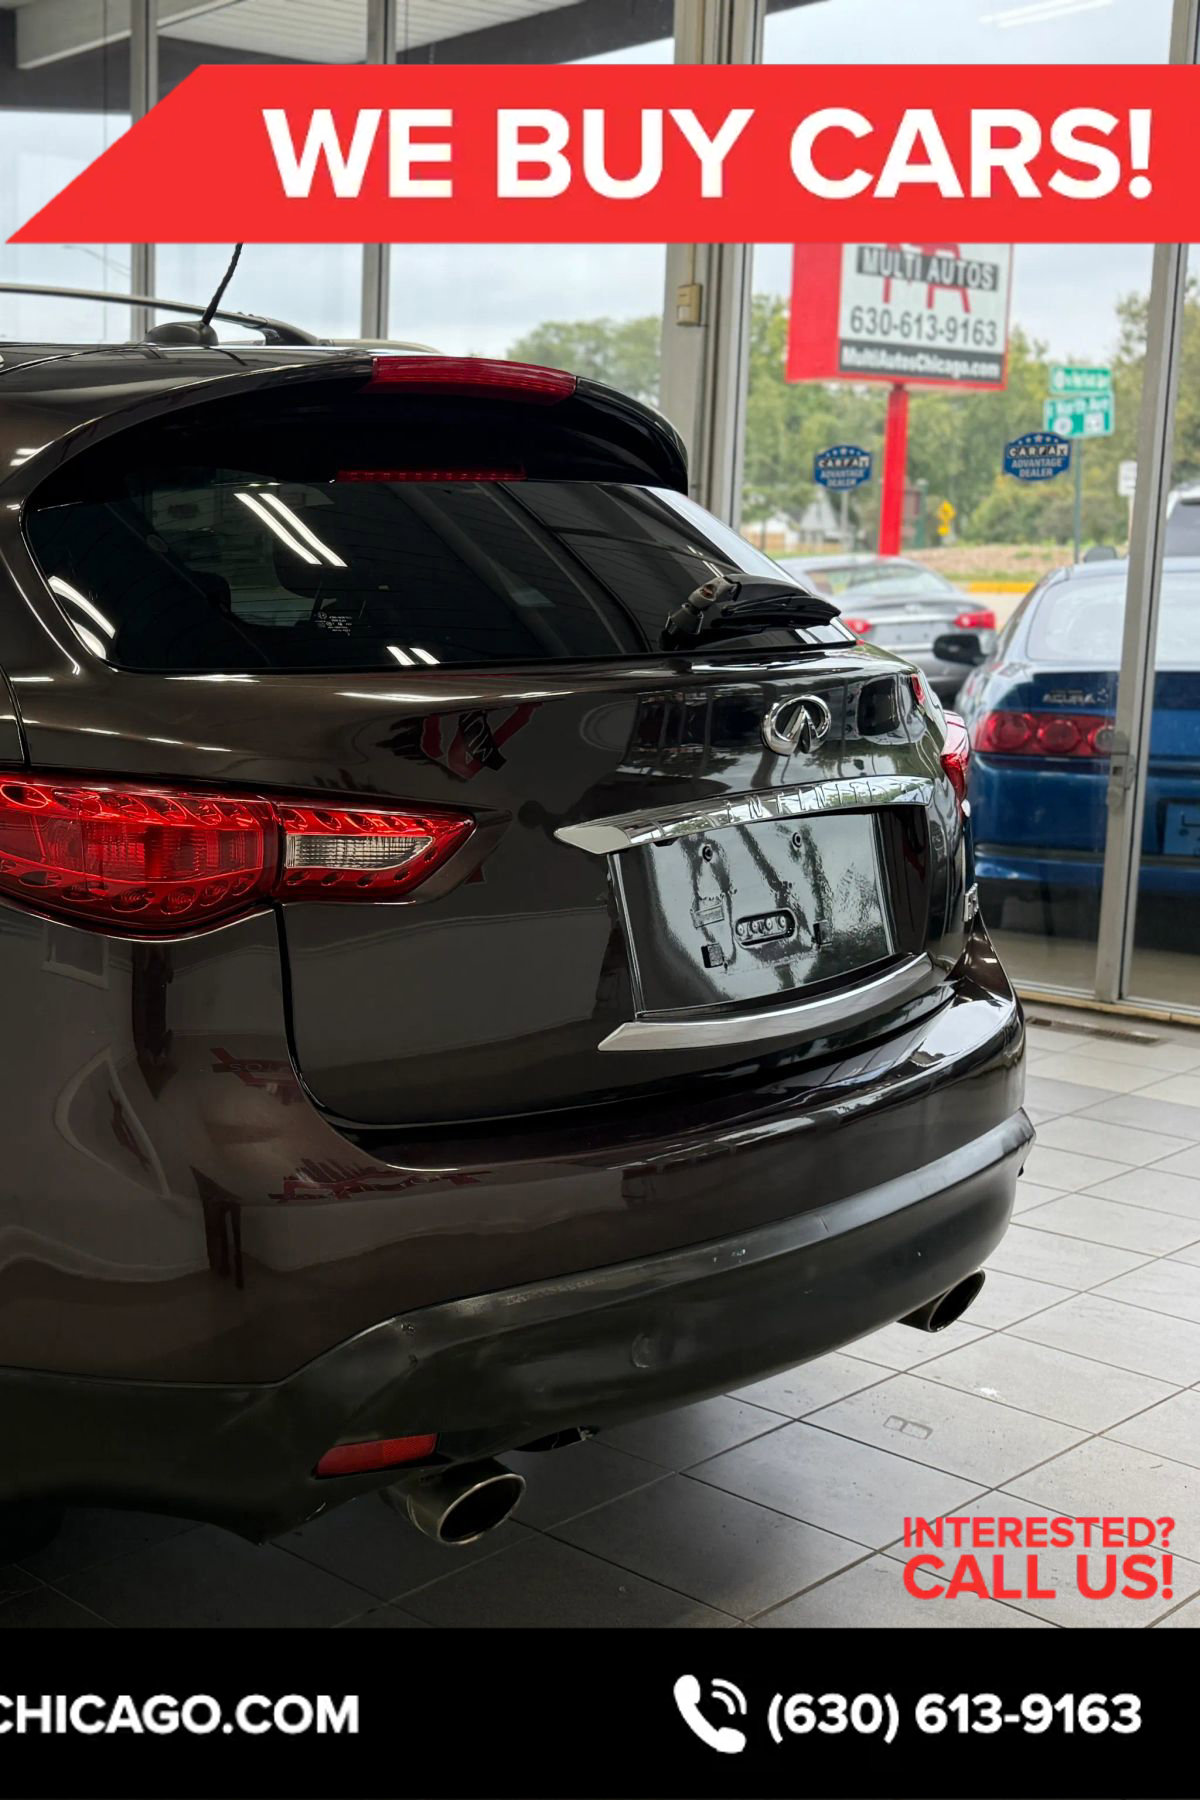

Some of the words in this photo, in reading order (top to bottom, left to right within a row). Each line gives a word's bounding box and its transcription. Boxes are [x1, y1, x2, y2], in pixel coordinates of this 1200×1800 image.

[861, 248, 922, 280] MULTI
[927, 257, 994, 289] AUTOS
[850, 305, 998, 347] 630-613-9163
[841, 346, 1001, 379] MultiAutosChicago.com
[1009, 444, 1068, 457] CARFAX
